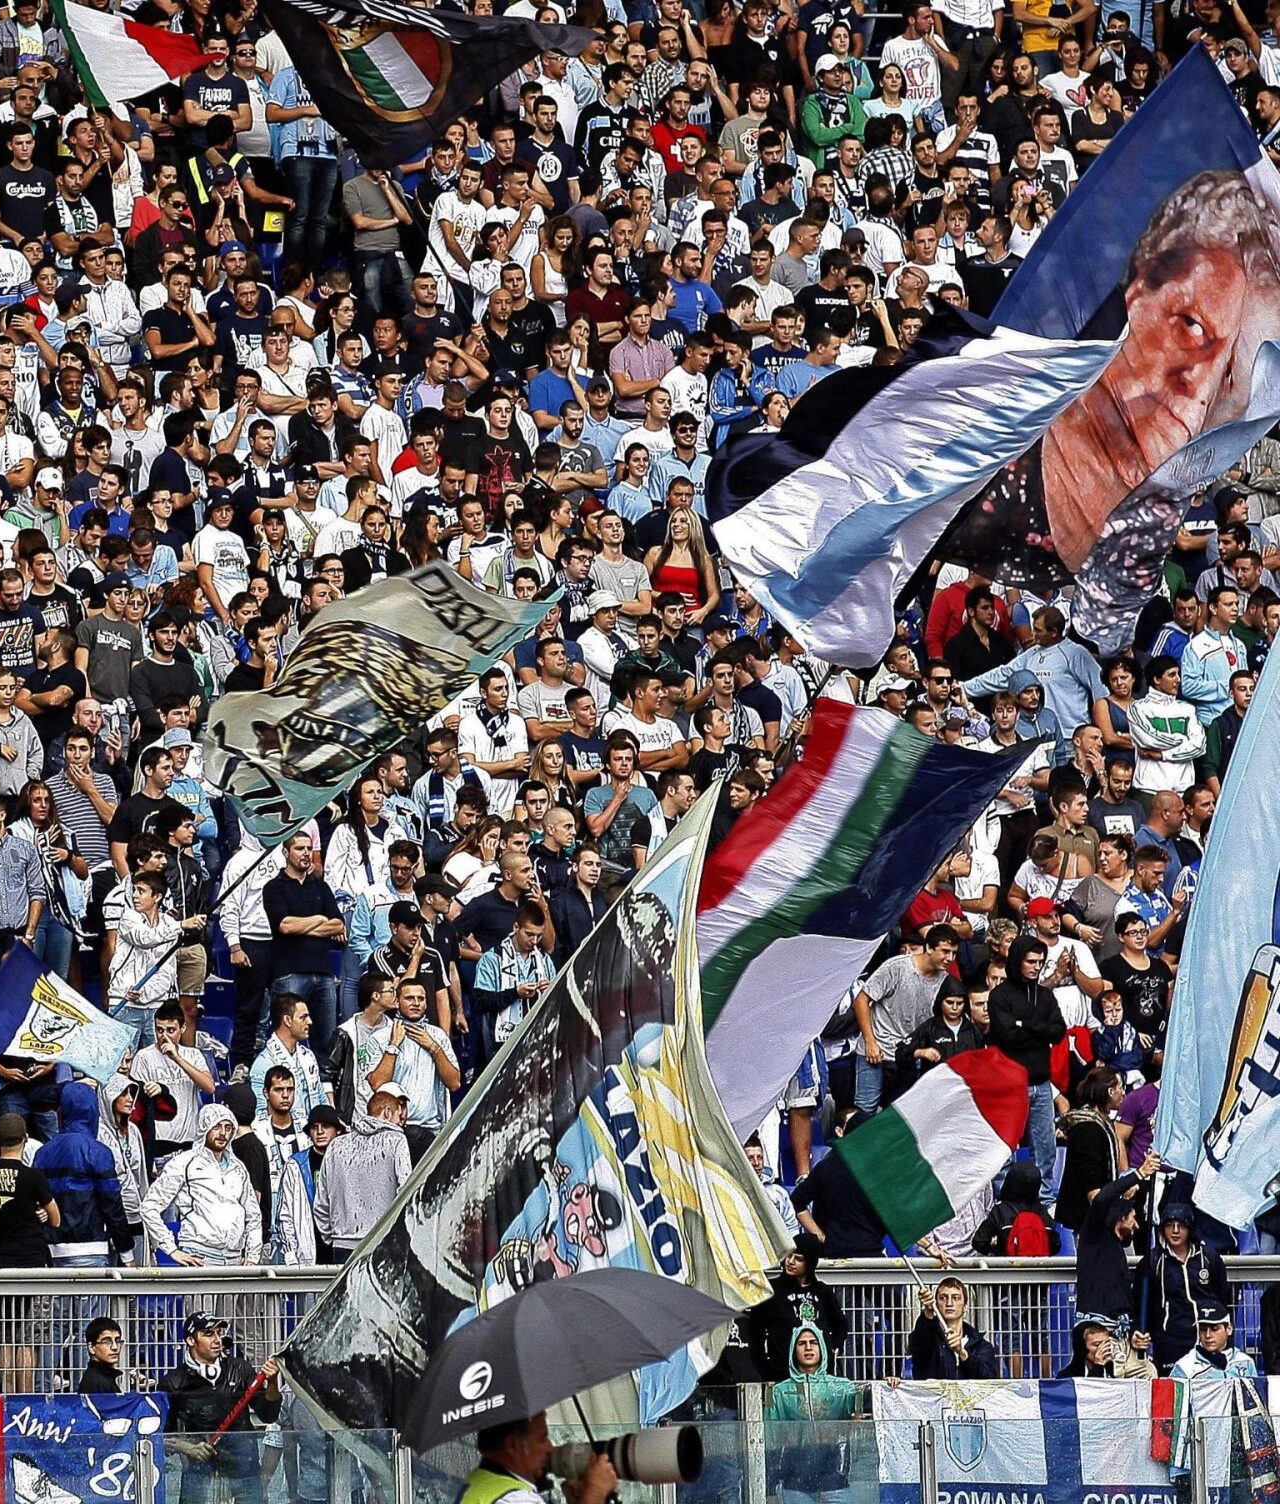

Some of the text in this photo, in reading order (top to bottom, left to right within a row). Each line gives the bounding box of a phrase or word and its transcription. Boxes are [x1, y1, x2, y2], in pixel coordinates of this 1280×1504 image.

[6, 182, 46, 199] Carlsberg
[443, 1394, 505, 1424] INESIS
[4, 1407, 77, 1443] Anni
